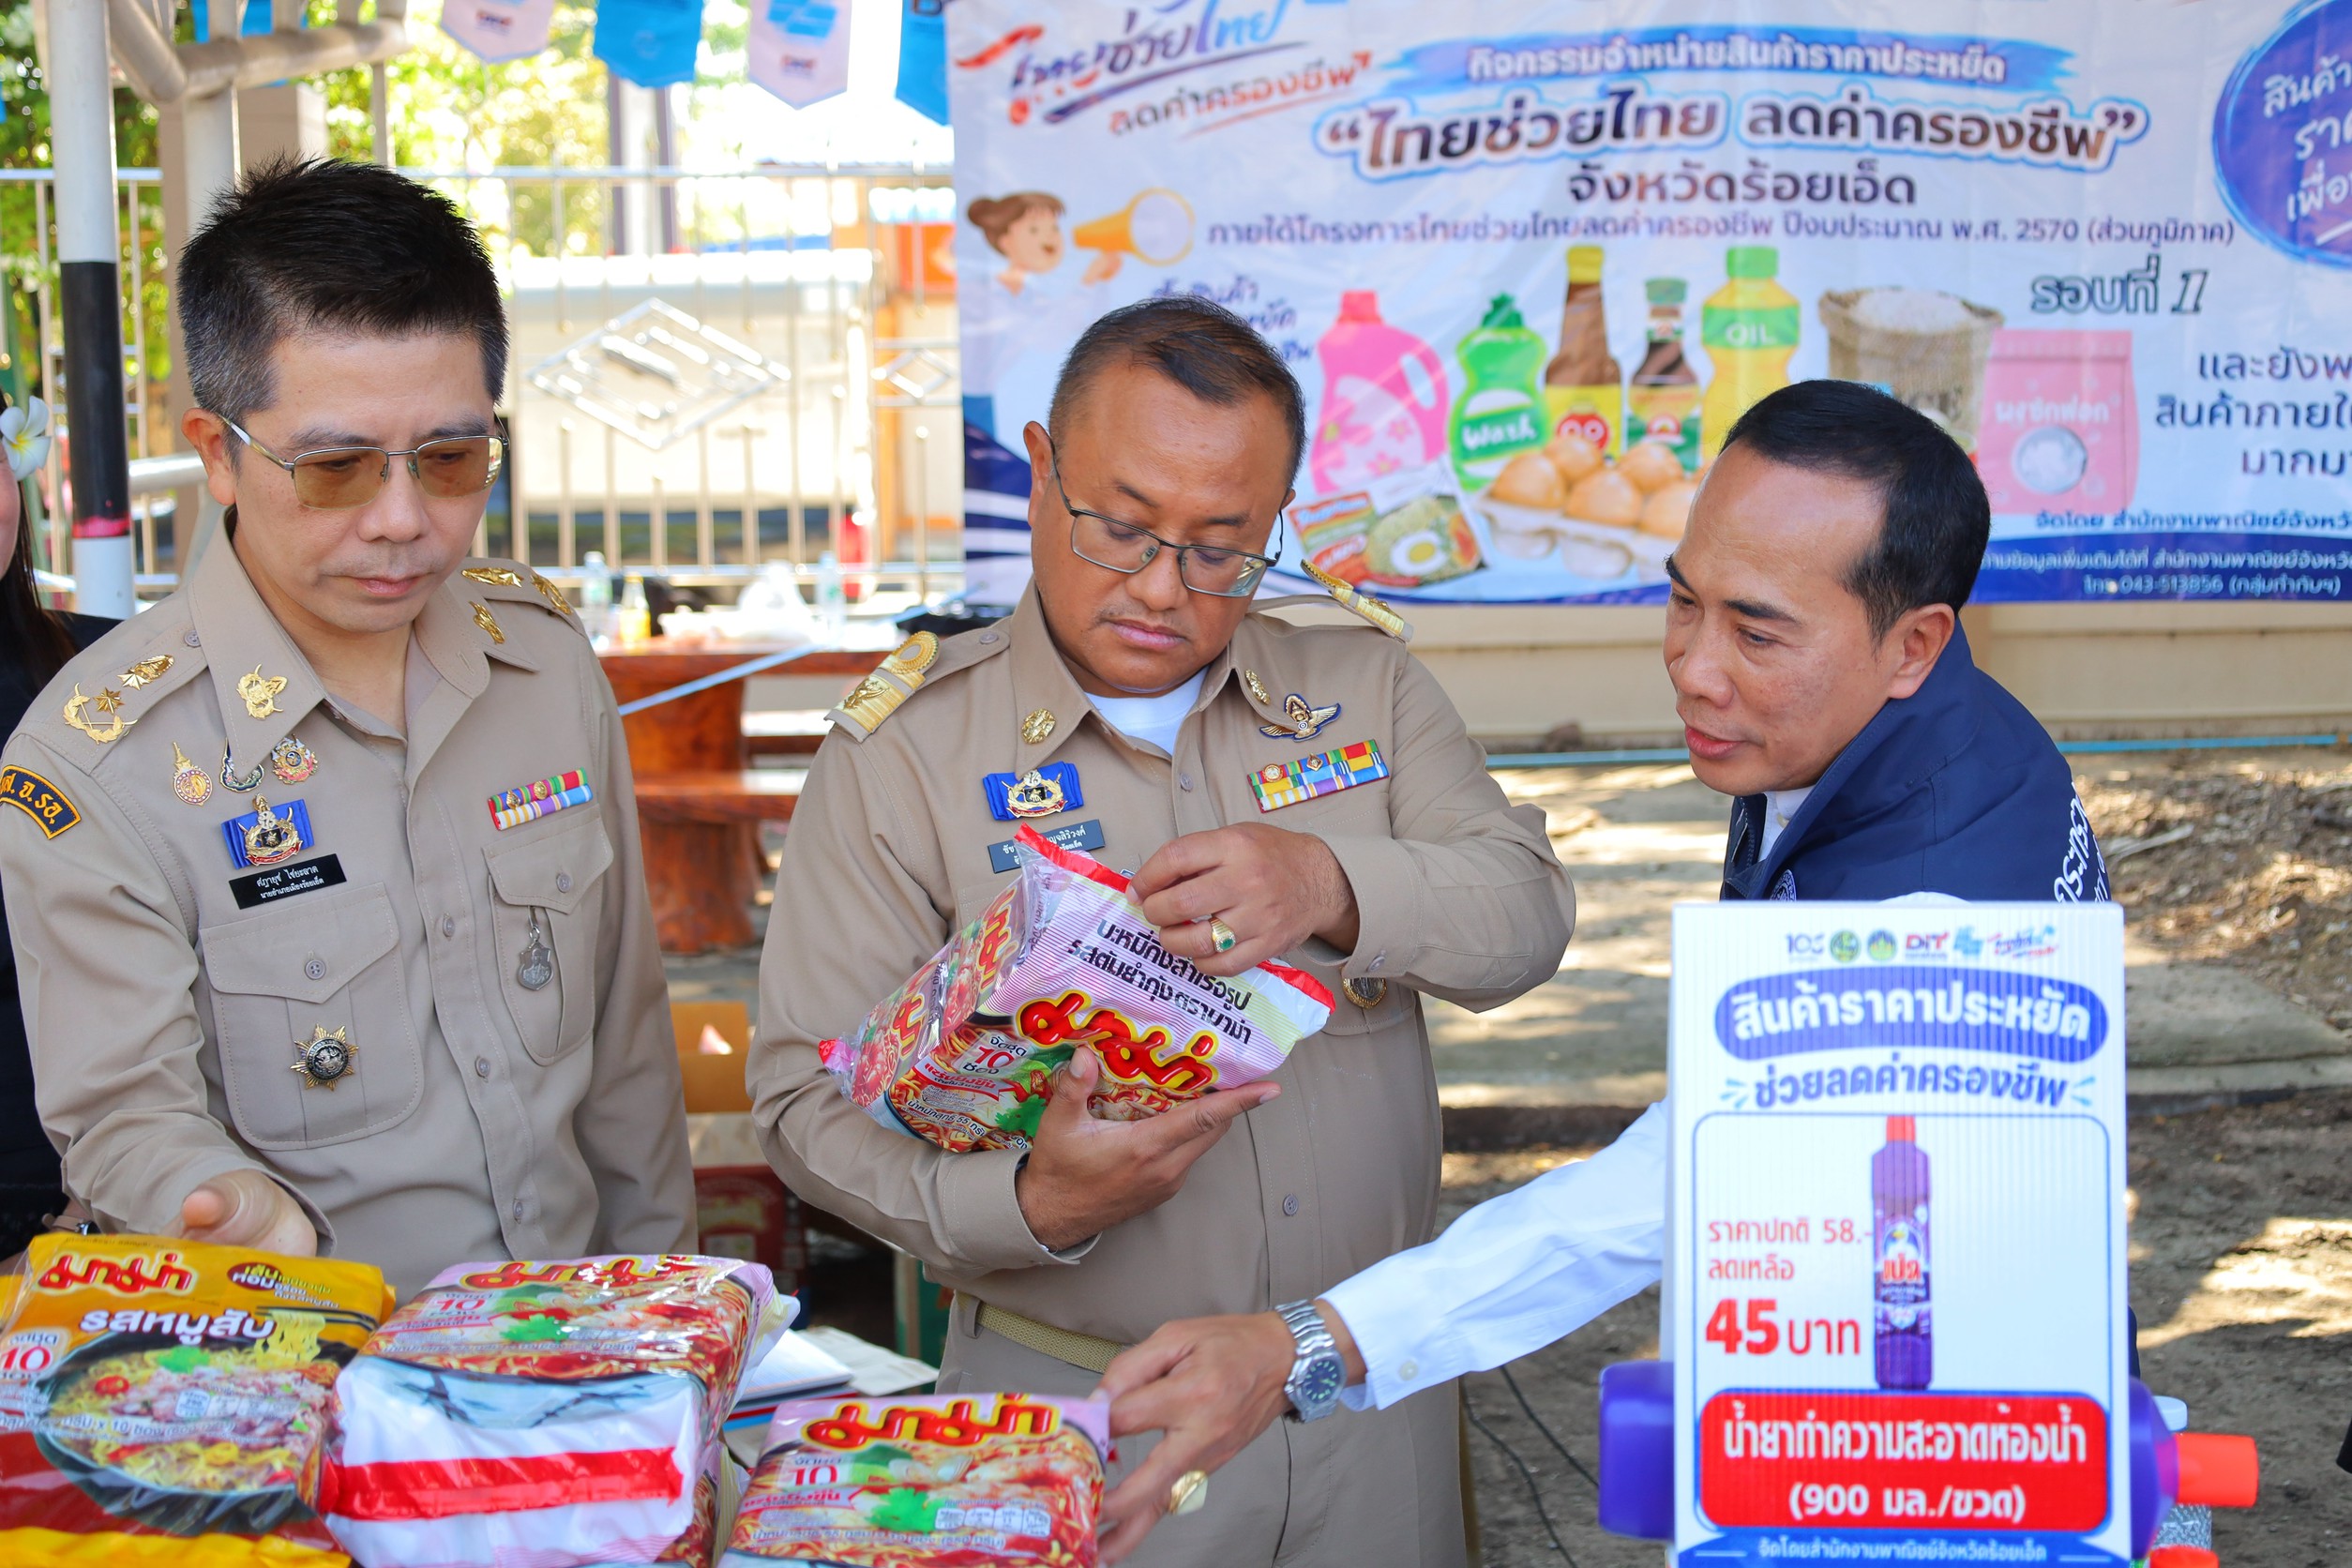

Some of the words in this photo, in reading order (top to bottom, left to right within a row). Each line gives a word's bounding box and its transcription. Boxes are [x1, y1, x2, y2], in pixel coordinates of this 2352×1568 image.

[2295, 108, 2352, 160] รา
[1569, 158, 1917, 205] จังหวัดร้อยเอ็ด
[2286, 158, 2352, 221] เพื่อ
[2016, 219, 2079, 242] 2570
[2030, 253, 2161, 314] รอบที่
[1726, 324, 1775, 346] OIL
[2156, 390, 2352, 430] สินค้าภายใ
[2242, 447, 2352, 476] มากม
[1732, 980, 2092, 1042] สินค้าราคาประหยัด
[974, 1046, 1015, 1069] 10
[1018, 992, 1217, 1092] มาม่า
[962, 1062, 1000, 1075] ซอง
[1755, 1051, 2069, 1108] ช่วยลดค่าครองชีพ
[956, 1116, 970, 1124] 55
[1709, 1218, 1810, 1244] ราคาปกติ
[38, 1252, 193, 1292] มาม่า
[1708, 1255, 1795, 1282] ลดเหลือ
[80, 1308, 278, 1346] รสหมูสับ
[1705, 1298, 1780, 1356] 45
[1788, 1319, 1861, 1356] บาท
[807, 1394, 1052, 1448] มาม่า
[1724, 1401, 2088, 1464] น้ำยาทำความสะอาดห้องน้ำ
[1789, 1483, 1870, 1520] (900
